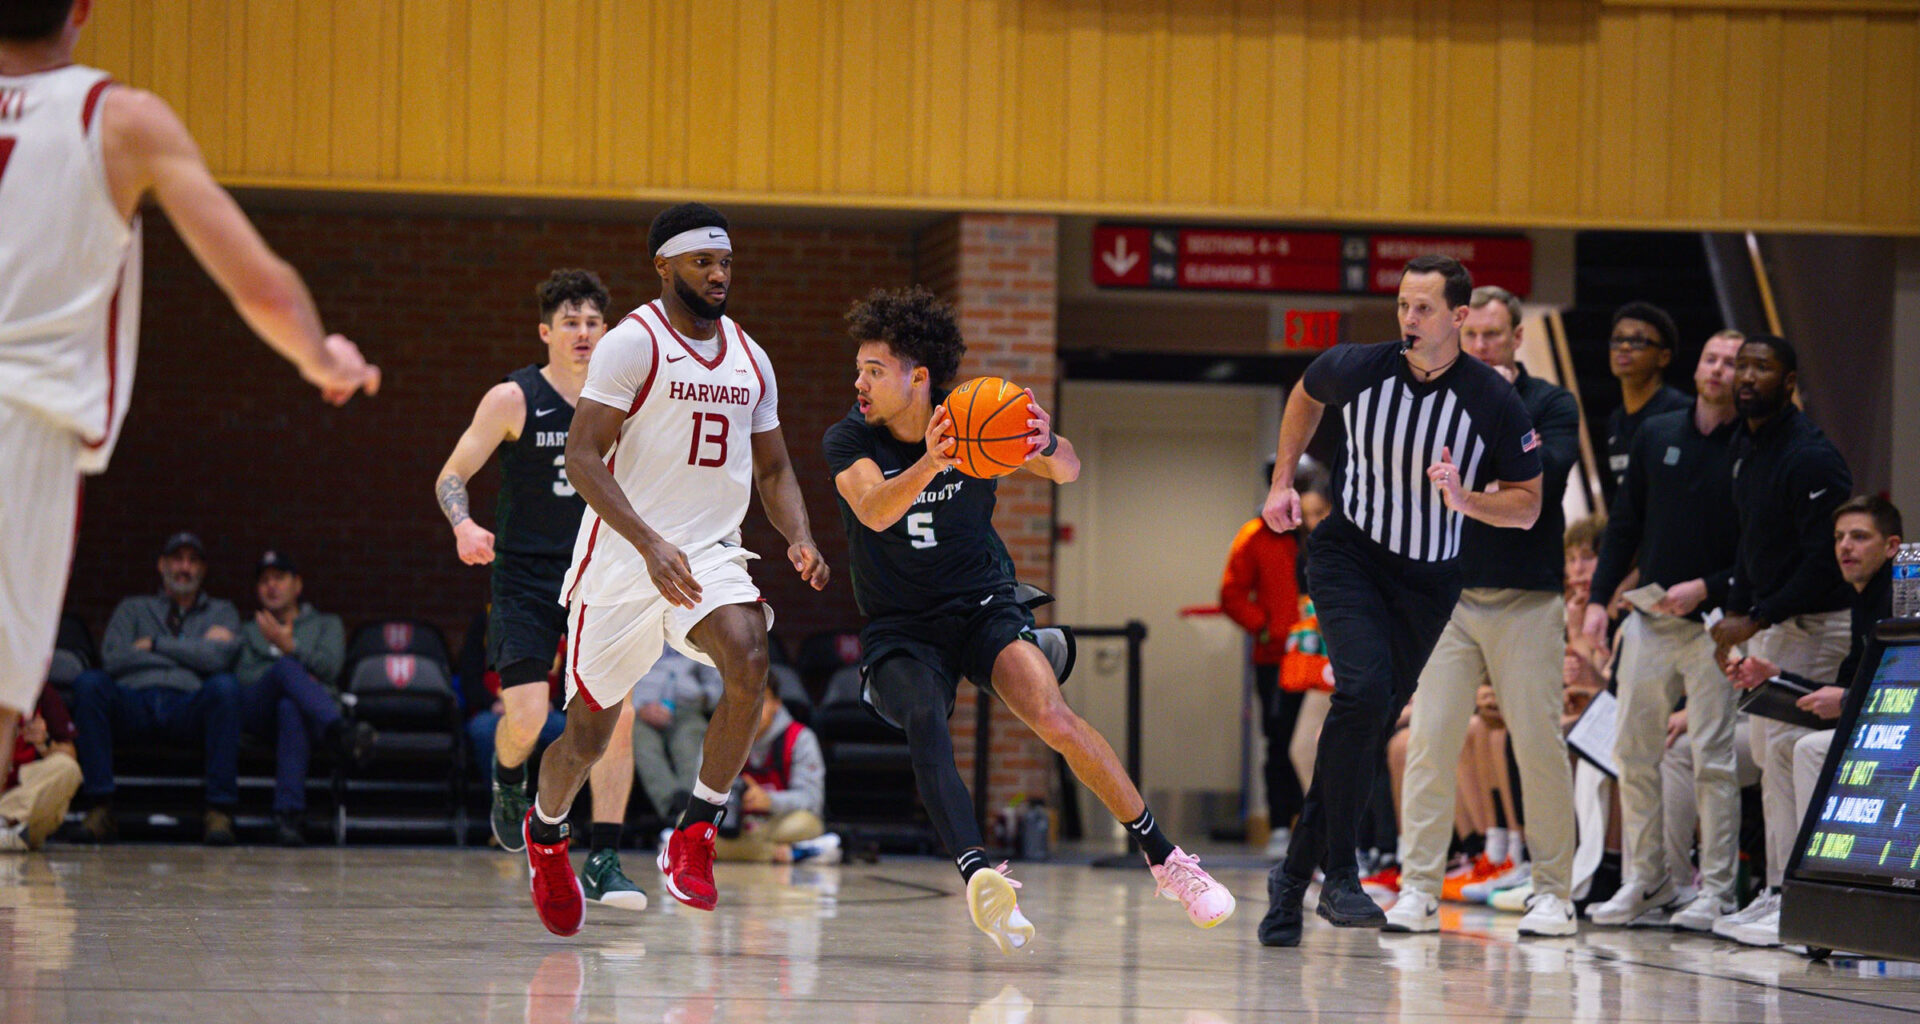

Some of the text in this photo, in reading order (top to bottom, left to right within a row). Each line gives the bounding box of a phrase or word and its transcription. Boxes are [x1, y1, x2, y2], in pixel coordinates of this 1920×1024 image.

[1285, 309, 1341, 349] EXIT
[669, 381, 750, 406] HARVARD
[536, 431, 568, 447] DAR
[688, 411, 729, 468] 13
[907, 512, 938, 550] 5
[1867, 688, 1918, 713] 2 THOMAS
[1853, 724, 1867, 749] 5
[1838, 760, 1854, 784] 11
